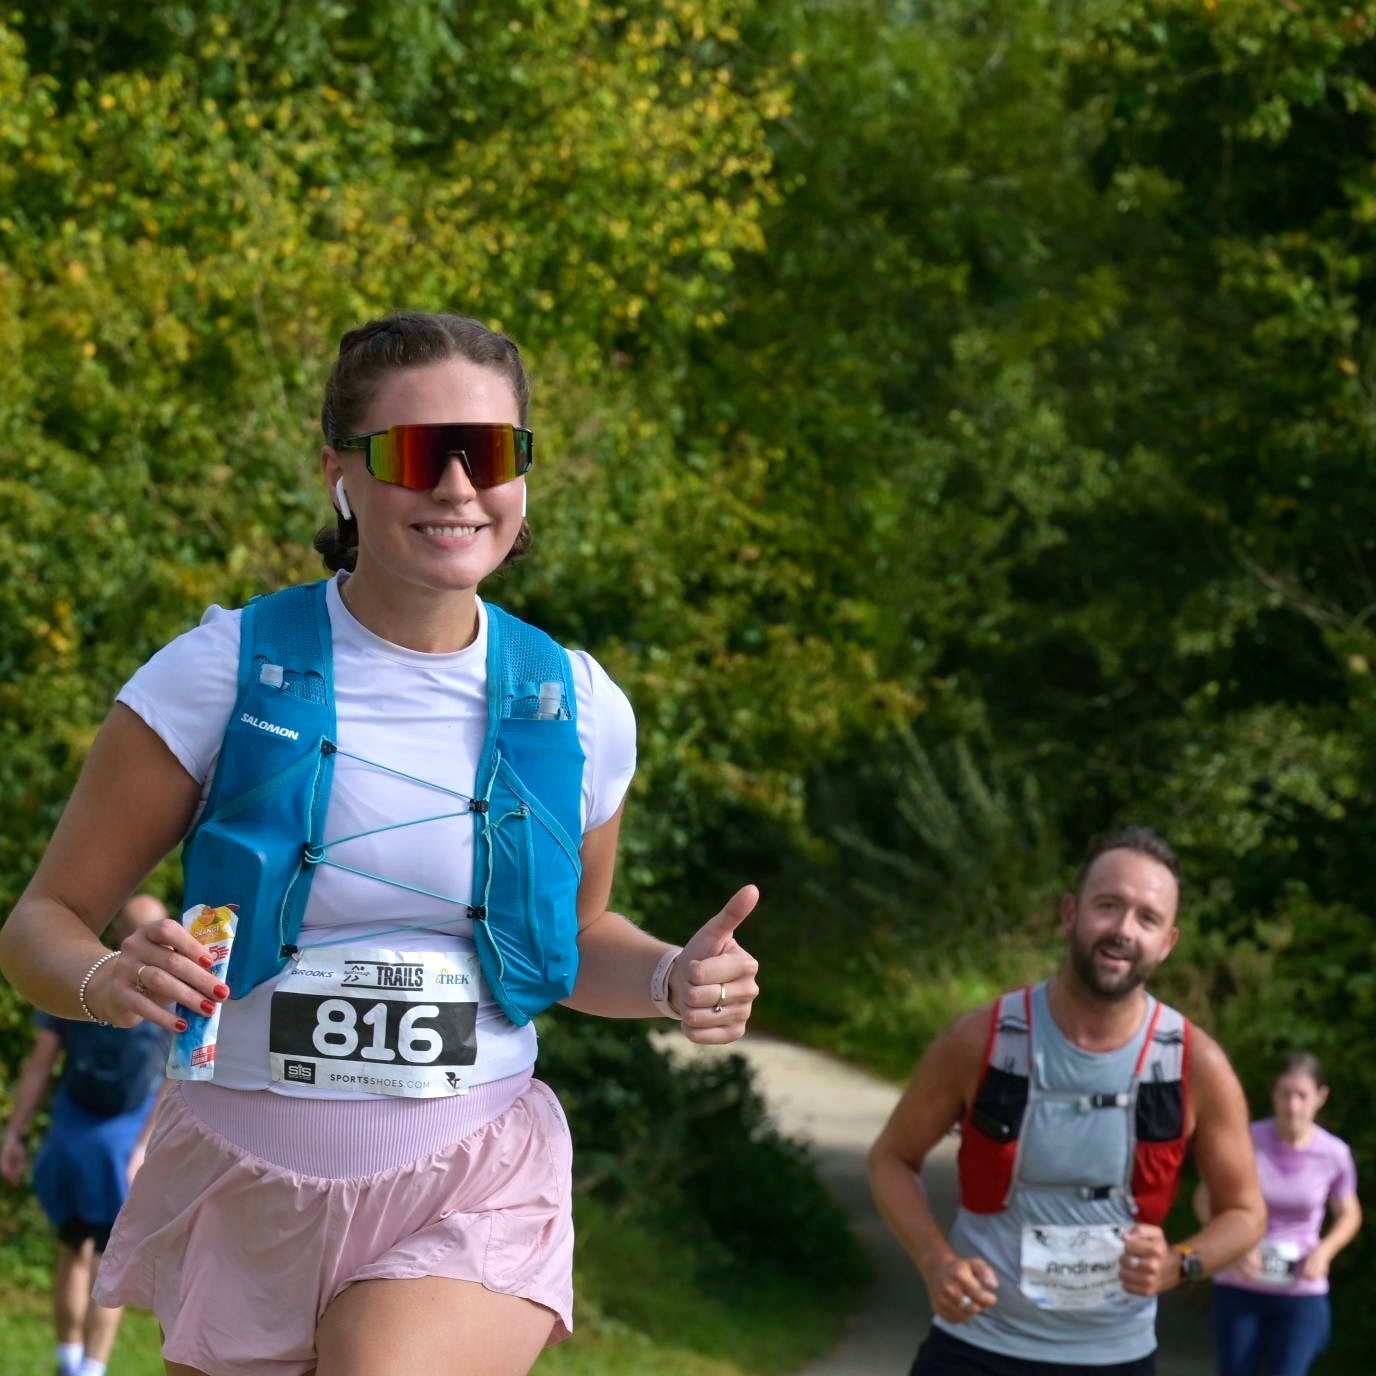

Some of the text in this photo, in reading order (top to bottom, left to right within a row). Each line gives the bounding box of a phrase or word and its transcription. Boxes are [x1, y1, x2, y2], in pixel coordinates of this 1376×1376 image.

[240, 713, 299, 740] SALOMON
[291, 969, 334, 978] BROOKS
[377, 966, 423, 988] TRAILS
[312, 999, 443, 1063] 816
[330, 1074, 431, 1088] SPORTSSHOES.COM
